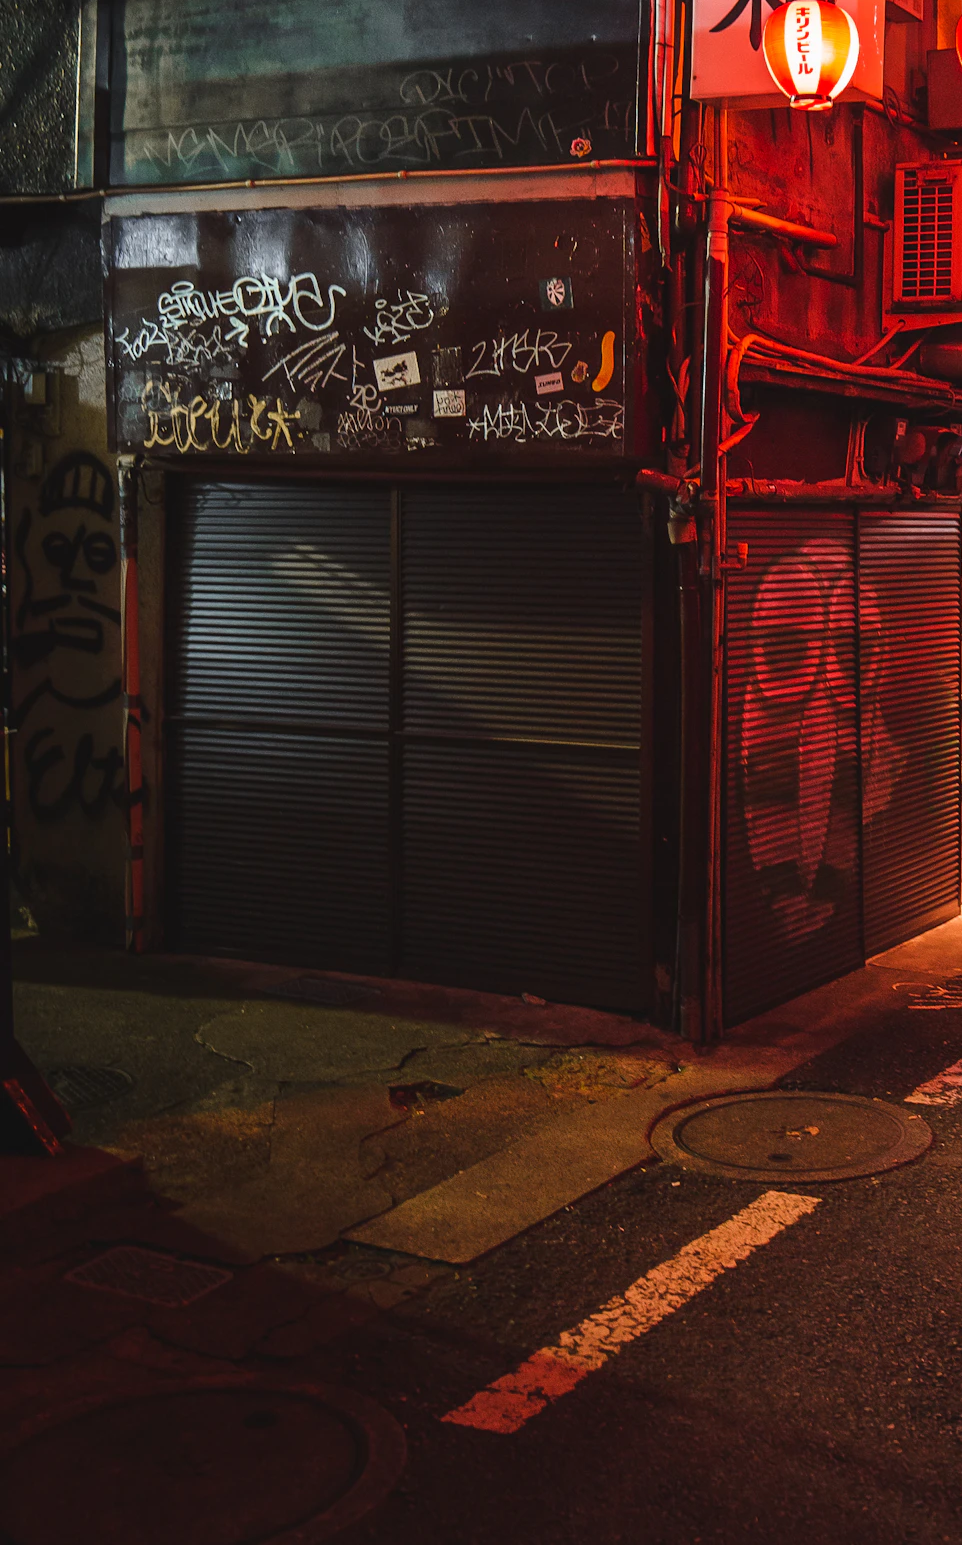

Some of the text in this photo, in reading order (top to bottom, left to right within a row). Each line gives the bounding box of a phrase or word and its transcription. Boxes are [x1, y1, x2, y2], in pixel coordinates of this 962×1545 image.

[795, 6, 814, 75] キリンビール
